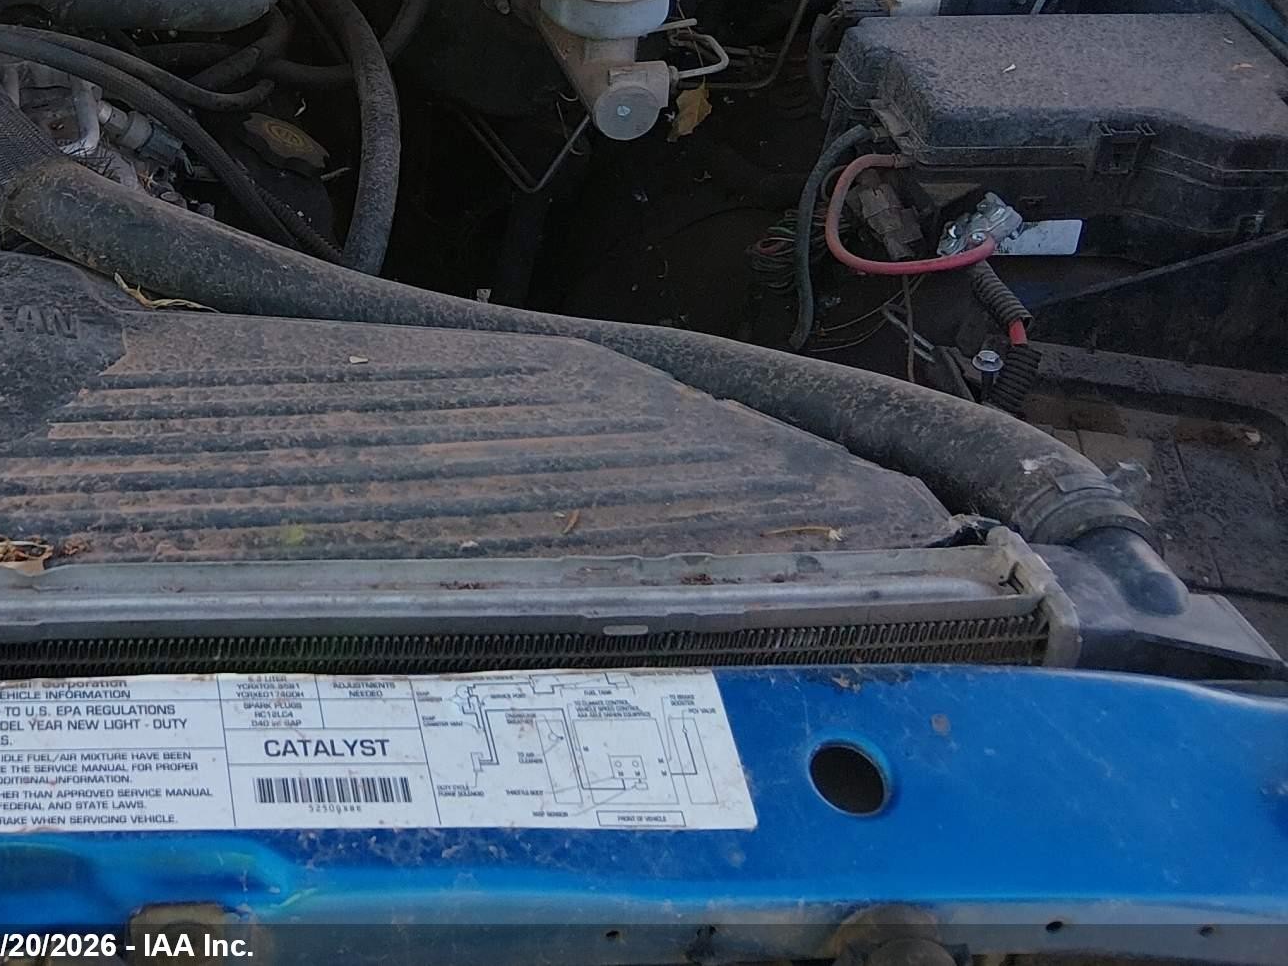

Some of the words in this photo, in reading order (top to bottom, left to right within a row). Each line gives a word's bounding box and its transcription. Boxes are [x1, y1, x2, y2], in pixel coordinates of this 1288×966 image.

[45, 689, 130, 701] INFORMATION
[5, 706, 20, 716] TO
[25, 705, 50, 717] U.S.
[56, 705, 82, 716] EPA
[86, 704, 175, 715] REGULATIONS
[28, 719, 62, 730] YEAR
[67, 719, 99, 730] NEW
[104, 719, 139, 729] LIGHT
[153, 718, 186, 729] DUTY
[264, 739, 389, 757] CATALYST
[1, 754, 23, 762] IDLE
[27, 753, 77, 762] FUEL/AIR
[80, 752, 127, 760] MIXTURE
[34, 764, 77, 772] SERVICE
[82, 763, 128, 772] MANUAL
[132, 763, 152, 771] FOR
[56, 775, 134, 785] INFORMATION.
[23, 790, 53, 798] THAN
[56, 789, 114, 797] APPROVED
[117, 789, 161, 797] SERVICE
[165, 788, 213, 796] MANUAL
[48, 801, 72, 809] AND
[76, 801, 108, 809] STATE
[112, 800, 145, 809] LAWS.
[31, 816, 66, 824] WHEN
[70, 815, 127, 824] SERVICING
[130, 814, 176, 823] VEHICLE.
